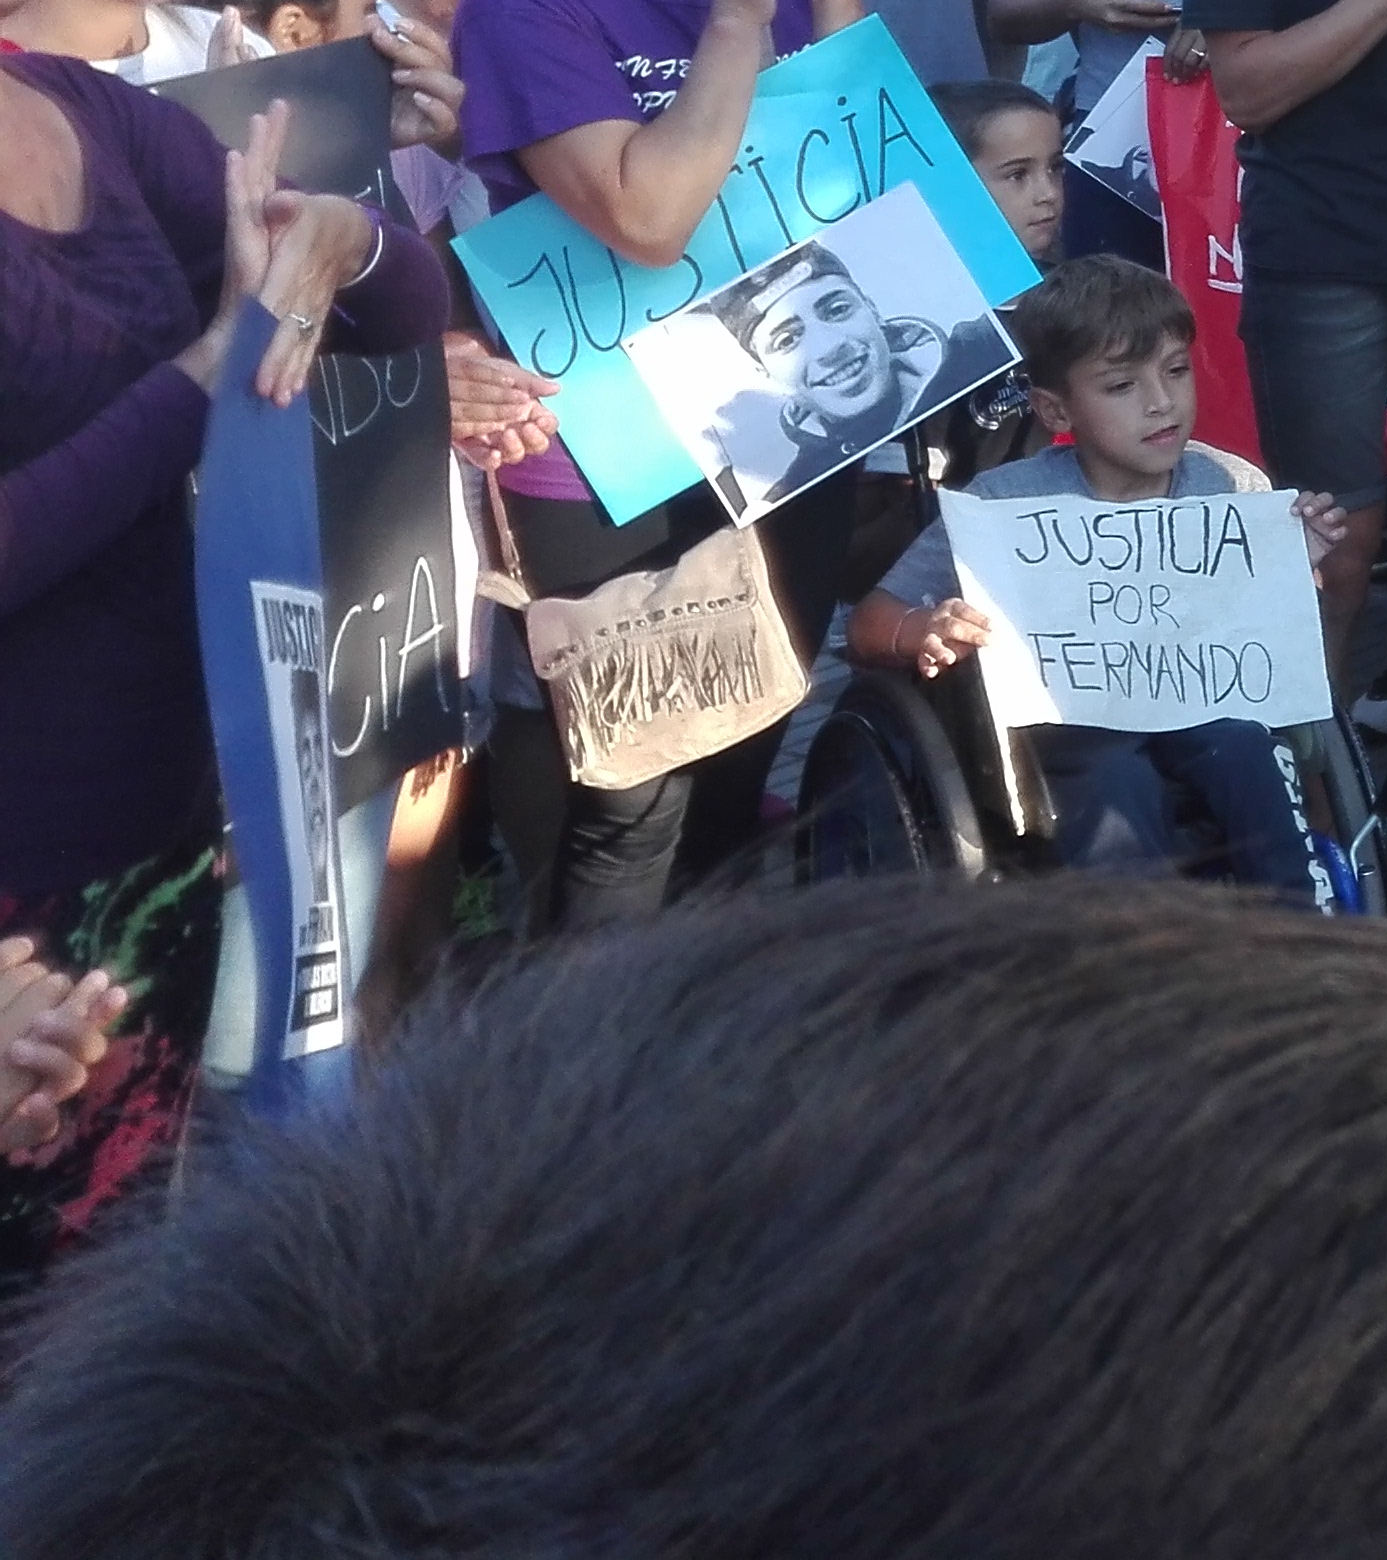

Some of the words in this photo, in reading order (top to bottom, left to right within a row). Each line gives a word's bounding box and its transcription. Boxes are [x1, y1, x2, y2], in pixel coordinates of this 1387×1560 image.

[1015, 499, 1256, 579] JUSTICIA
[1088, 581, 1181, 629] POR
[1027, 632, 1273, 708] FERNANDO
